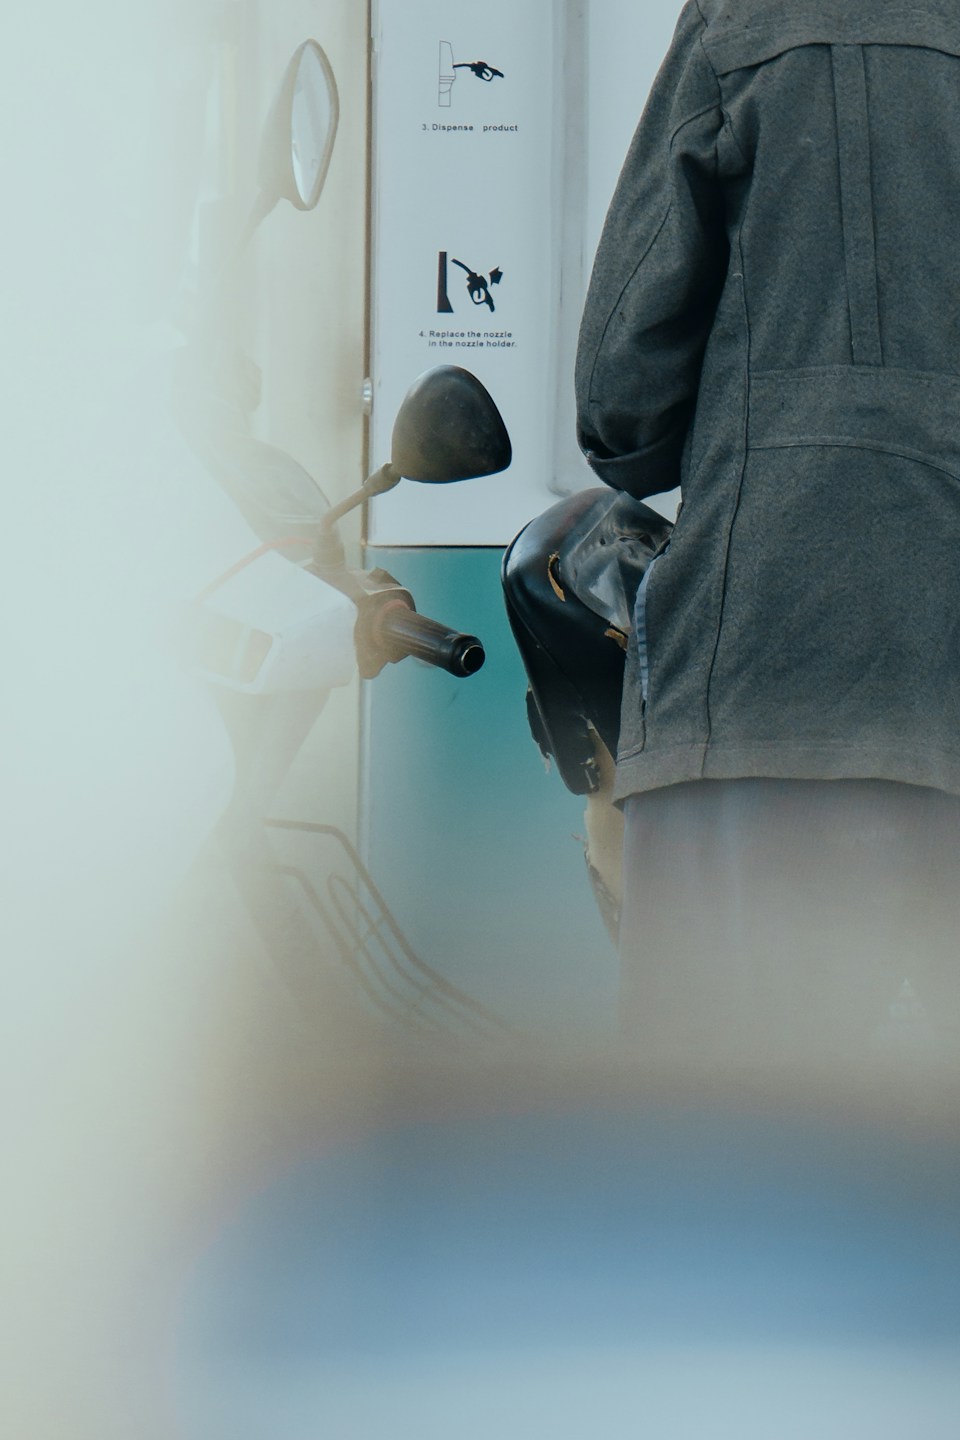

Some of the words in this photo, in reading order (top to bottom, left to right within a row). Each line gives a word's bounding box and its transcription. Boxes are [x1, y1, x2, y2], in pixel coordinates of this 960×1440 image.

[432, 123, 474, 132] Dispense
[483, 124, 518, 132] product
[429, 330, 465, 339] Replace
[467, 330, 481, 338] the
[483, 330, 512, 338] nozzle
